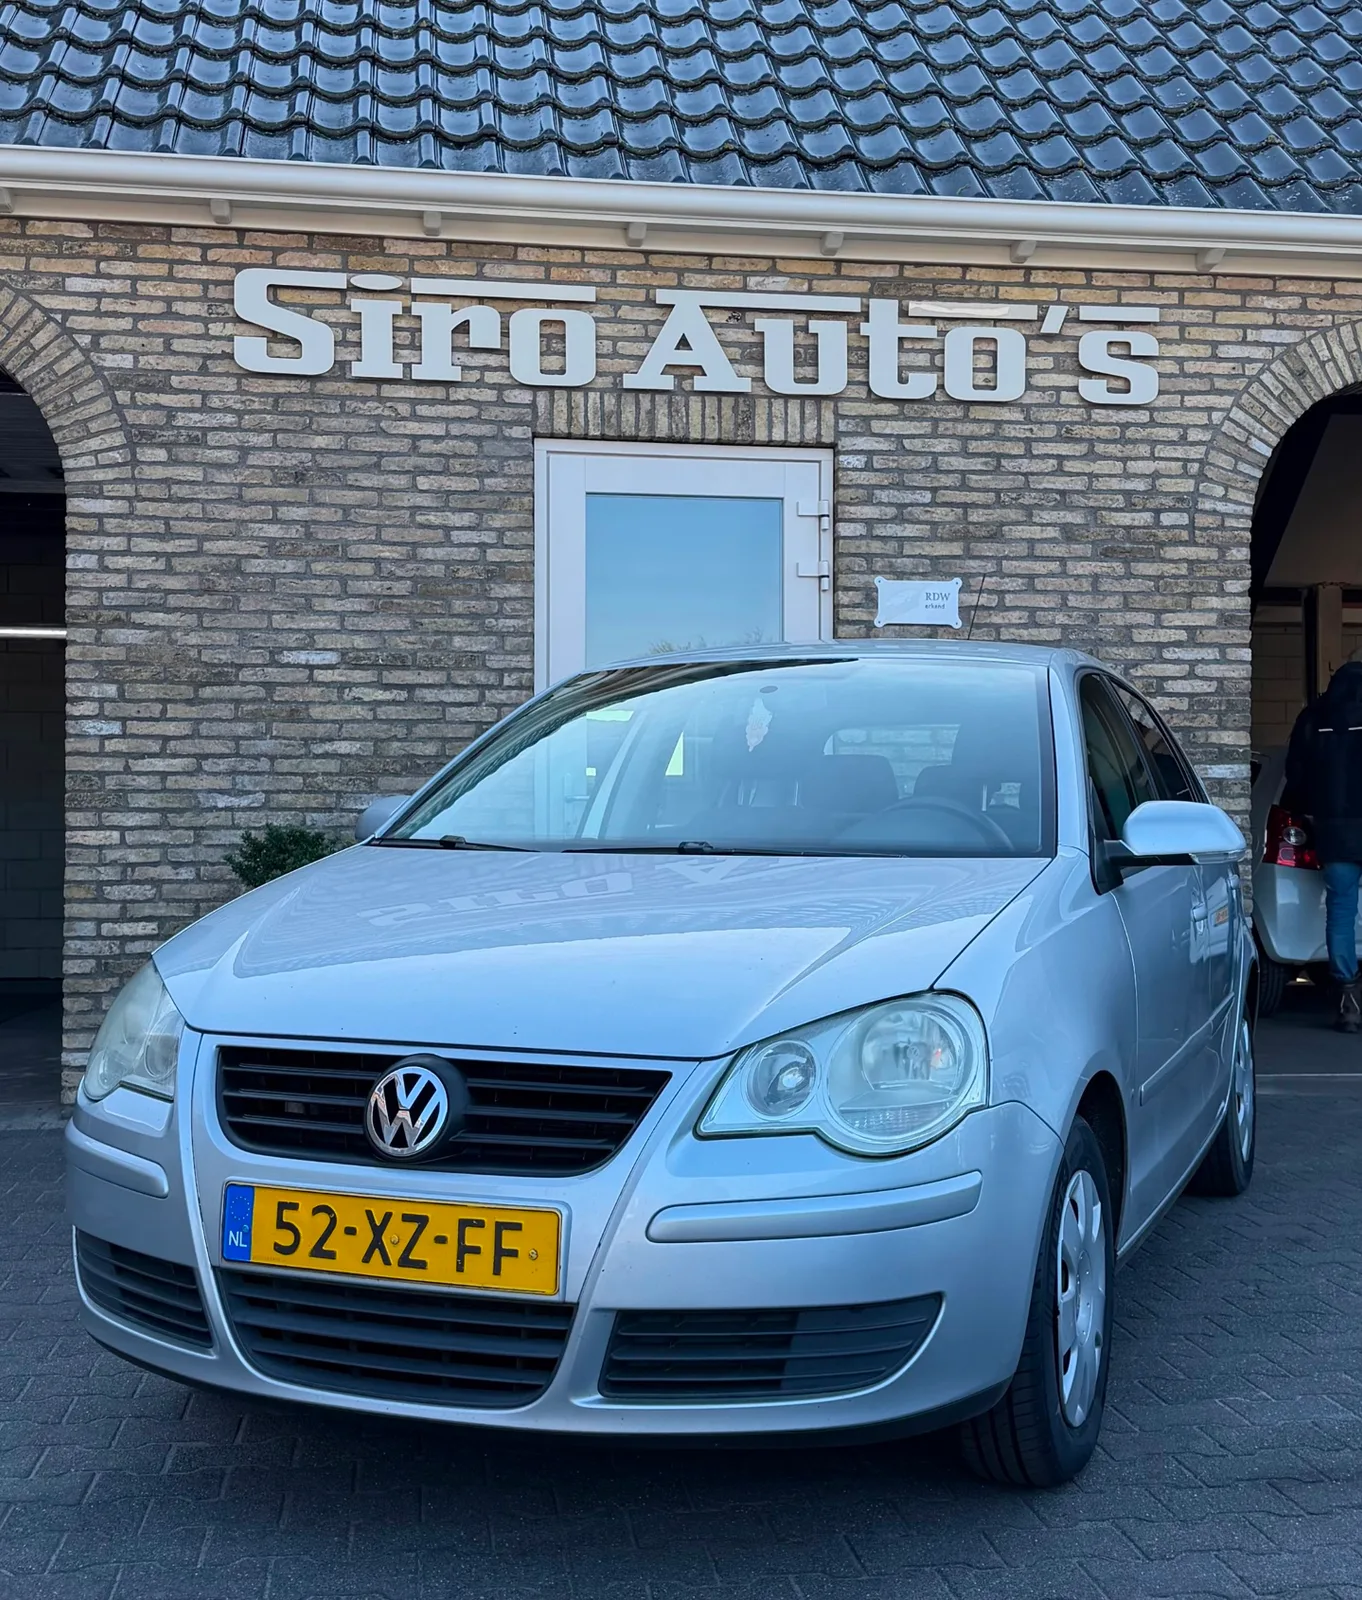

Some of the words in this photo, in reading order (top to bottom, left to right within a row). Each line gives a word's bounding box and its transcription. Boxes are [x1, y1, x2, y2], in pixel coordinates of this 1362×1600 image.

[232, 267, 597, 387] Siro
[621, 288, 1161, 406] Auto's
[925, 592, 951, 601] RDW
[367, 1066, 448, 1157] VW
[228, 1230, 248, 1248] NL
[272, 1200, 523, 1276] 52-XZ-FF
